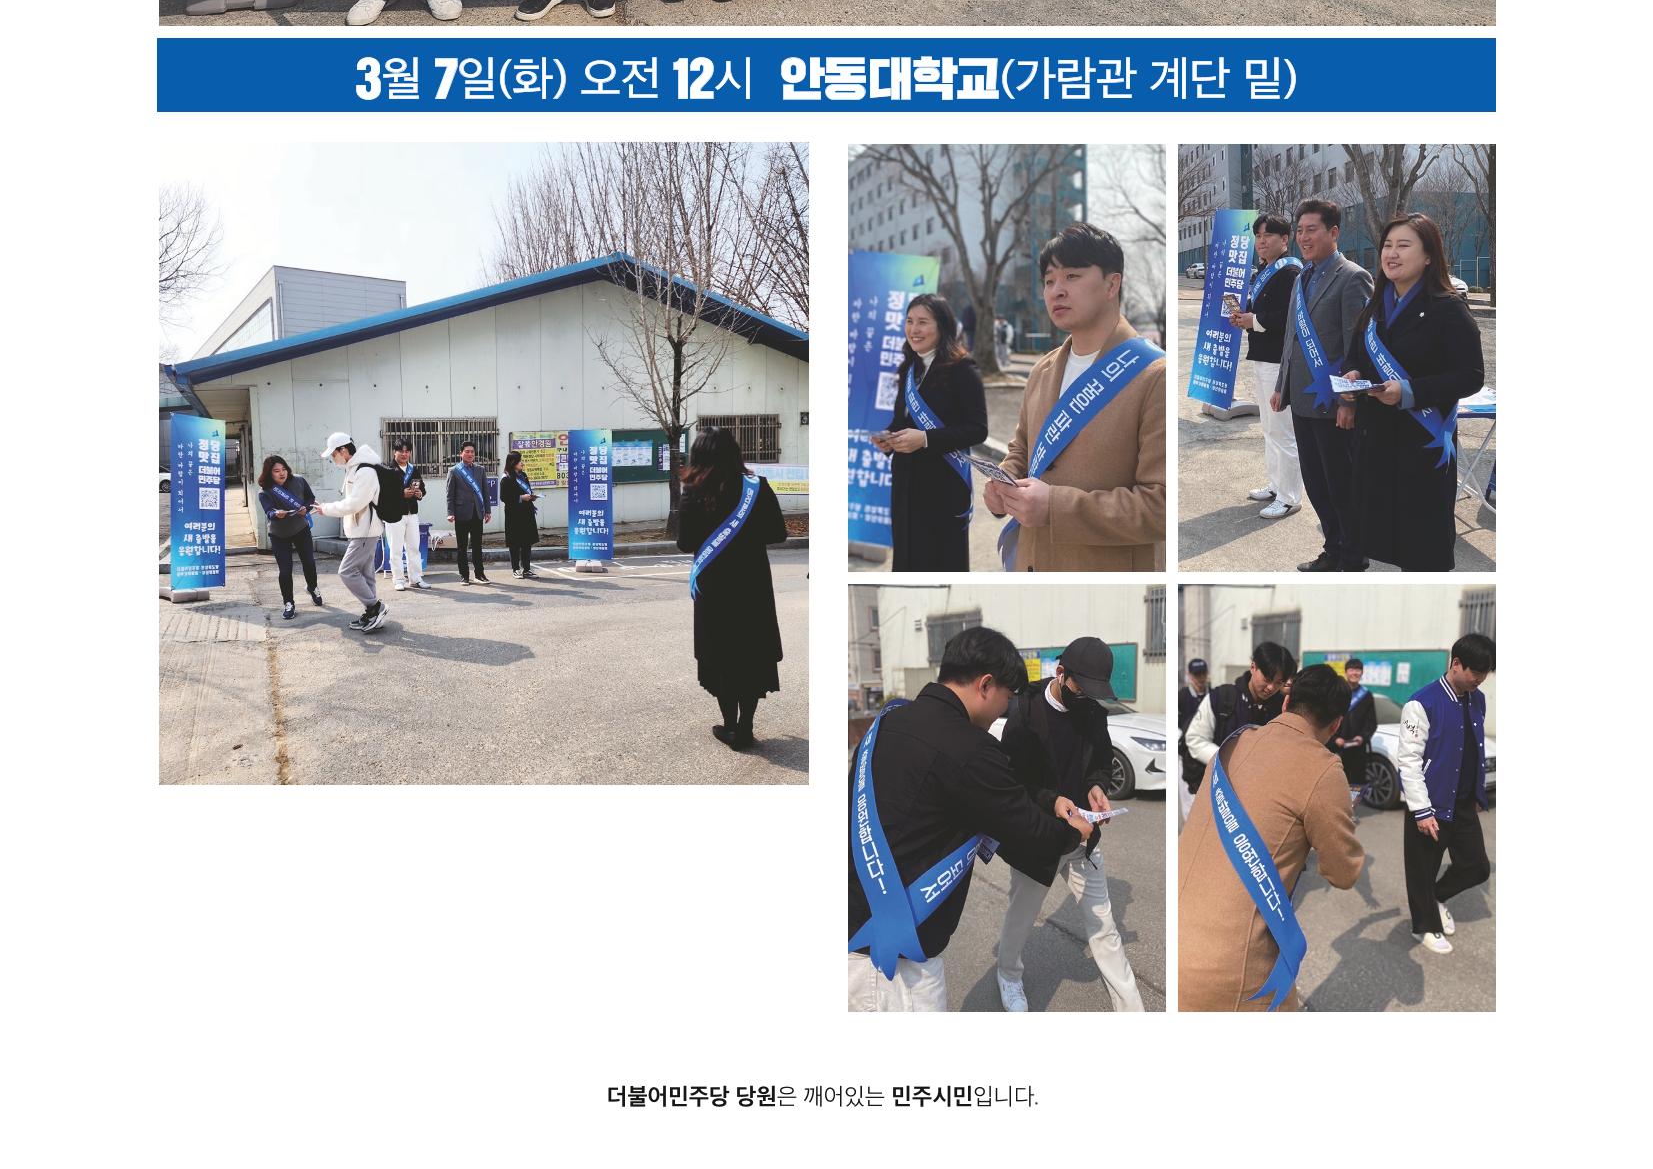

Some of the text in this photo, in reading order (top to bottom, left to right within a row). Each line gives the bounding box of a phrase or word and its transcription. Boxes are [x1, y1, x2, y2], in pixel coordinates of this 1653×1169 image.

[1101, 348, 1140, 382] 나의
[1069, 378, 1104, 415] 꿈은
[1045, 410, 1073, 446] 파란
[857, 793, 887, 895] 응원합니다!
[1233, 833, 1285, 922] 응원합니다!
